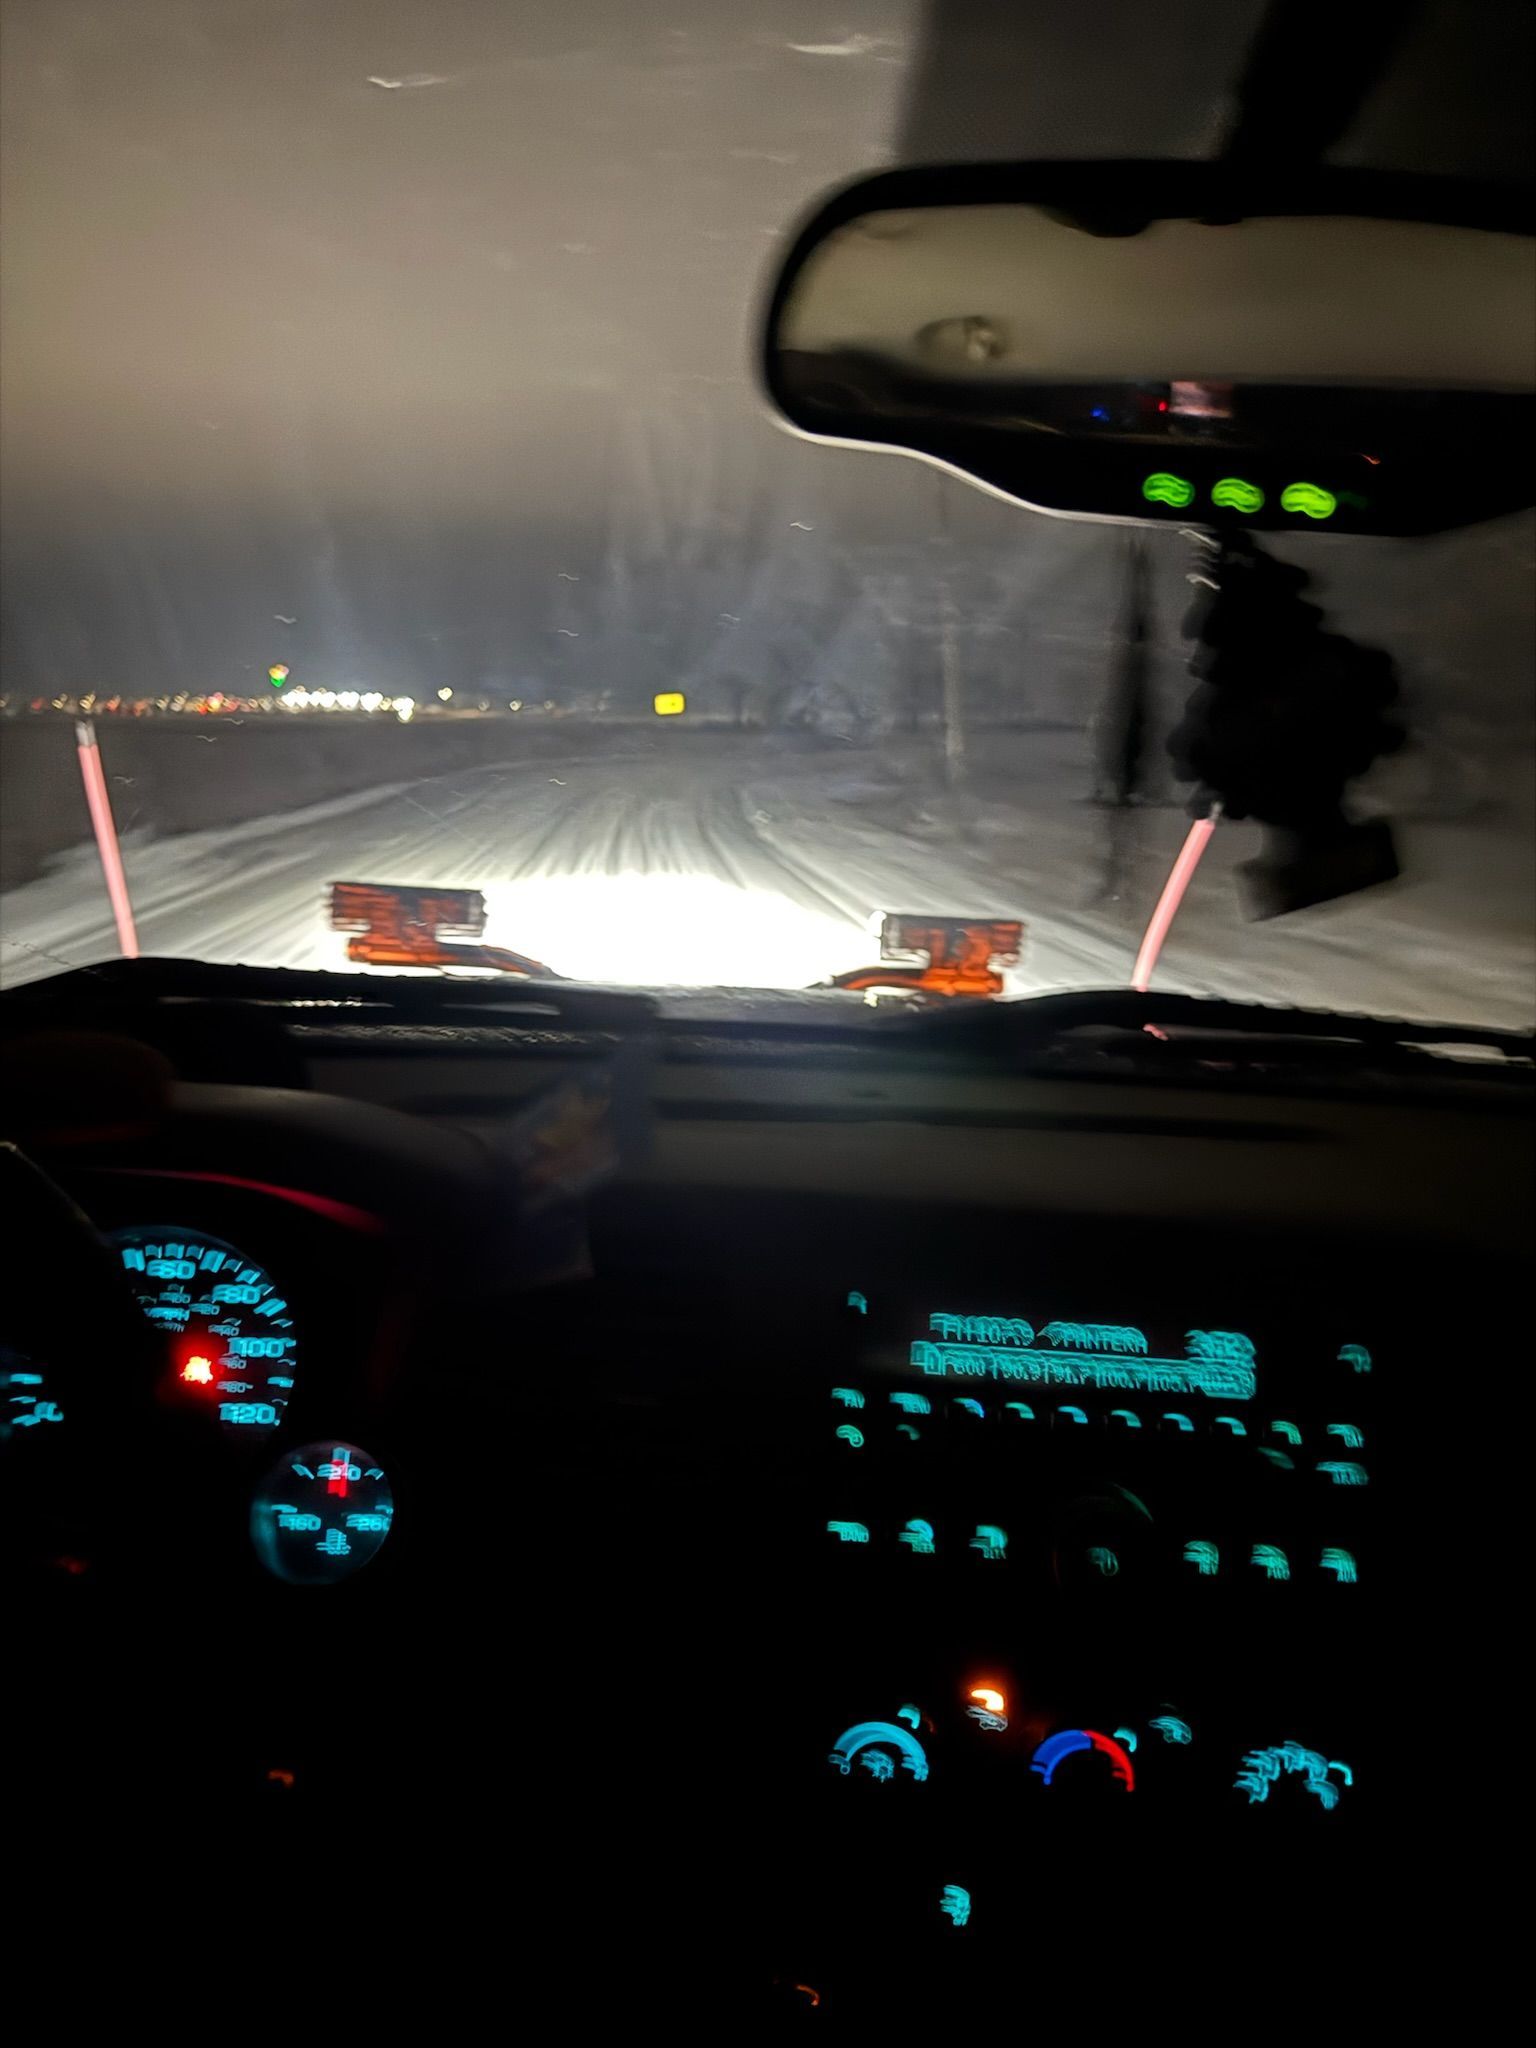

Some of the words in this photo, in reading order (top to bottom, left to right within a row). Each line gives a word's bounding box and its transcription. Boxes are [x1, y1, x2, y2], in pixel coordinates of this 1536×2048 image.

[212, 1284, 260, 1304] 80
[227, 1336, 285, 1358] 100
[218, 1402, 276, 1424] 120
